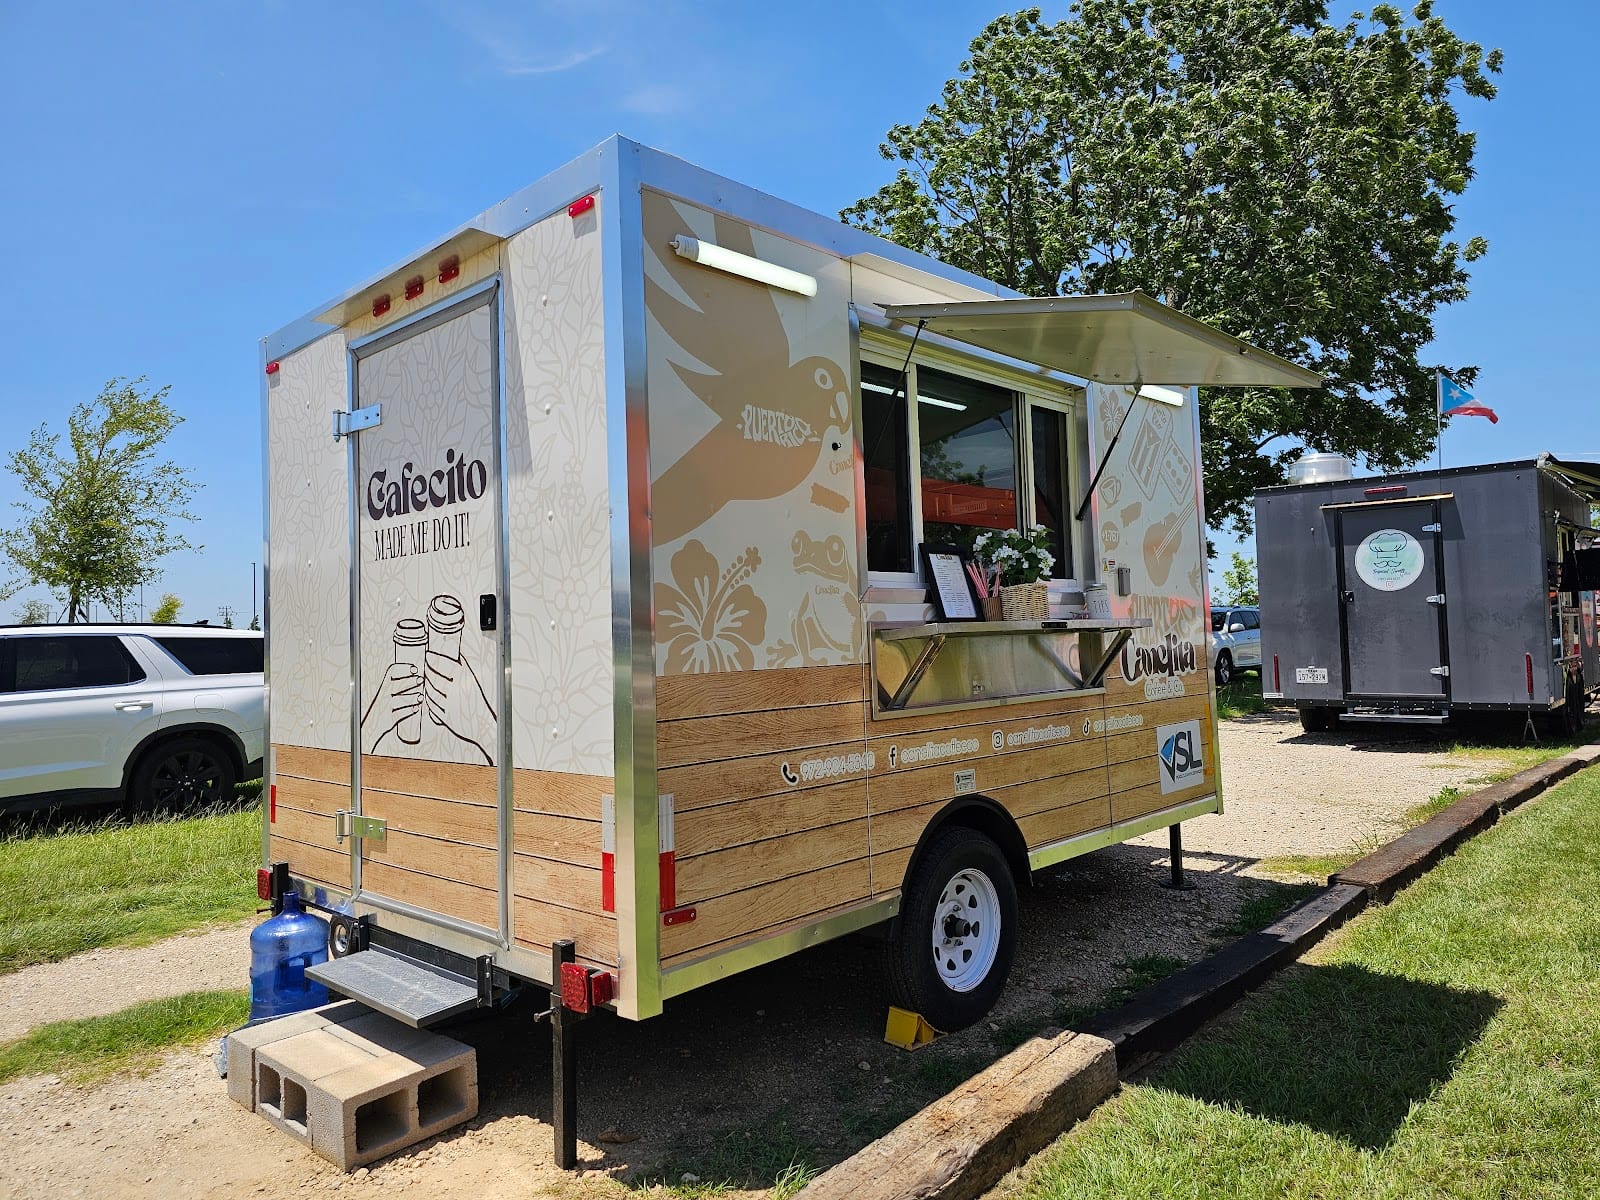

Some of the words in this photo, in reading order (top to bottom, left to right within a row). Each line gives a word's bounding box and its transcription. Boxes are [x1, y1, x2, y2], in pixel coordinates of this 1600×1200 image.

[741, 404, 796, 446] PUERTO
[780, 417, 811, 448] RICO
[367, 448, 487, 521] Cafecito
[374, 524, 407, 562] MADE
[410, 520, 429, 556] ME
[433, 516, 451, 552] DO
[454, 512, 470, 549] IT!
[1121, 632, 1196, 682] Canelita
